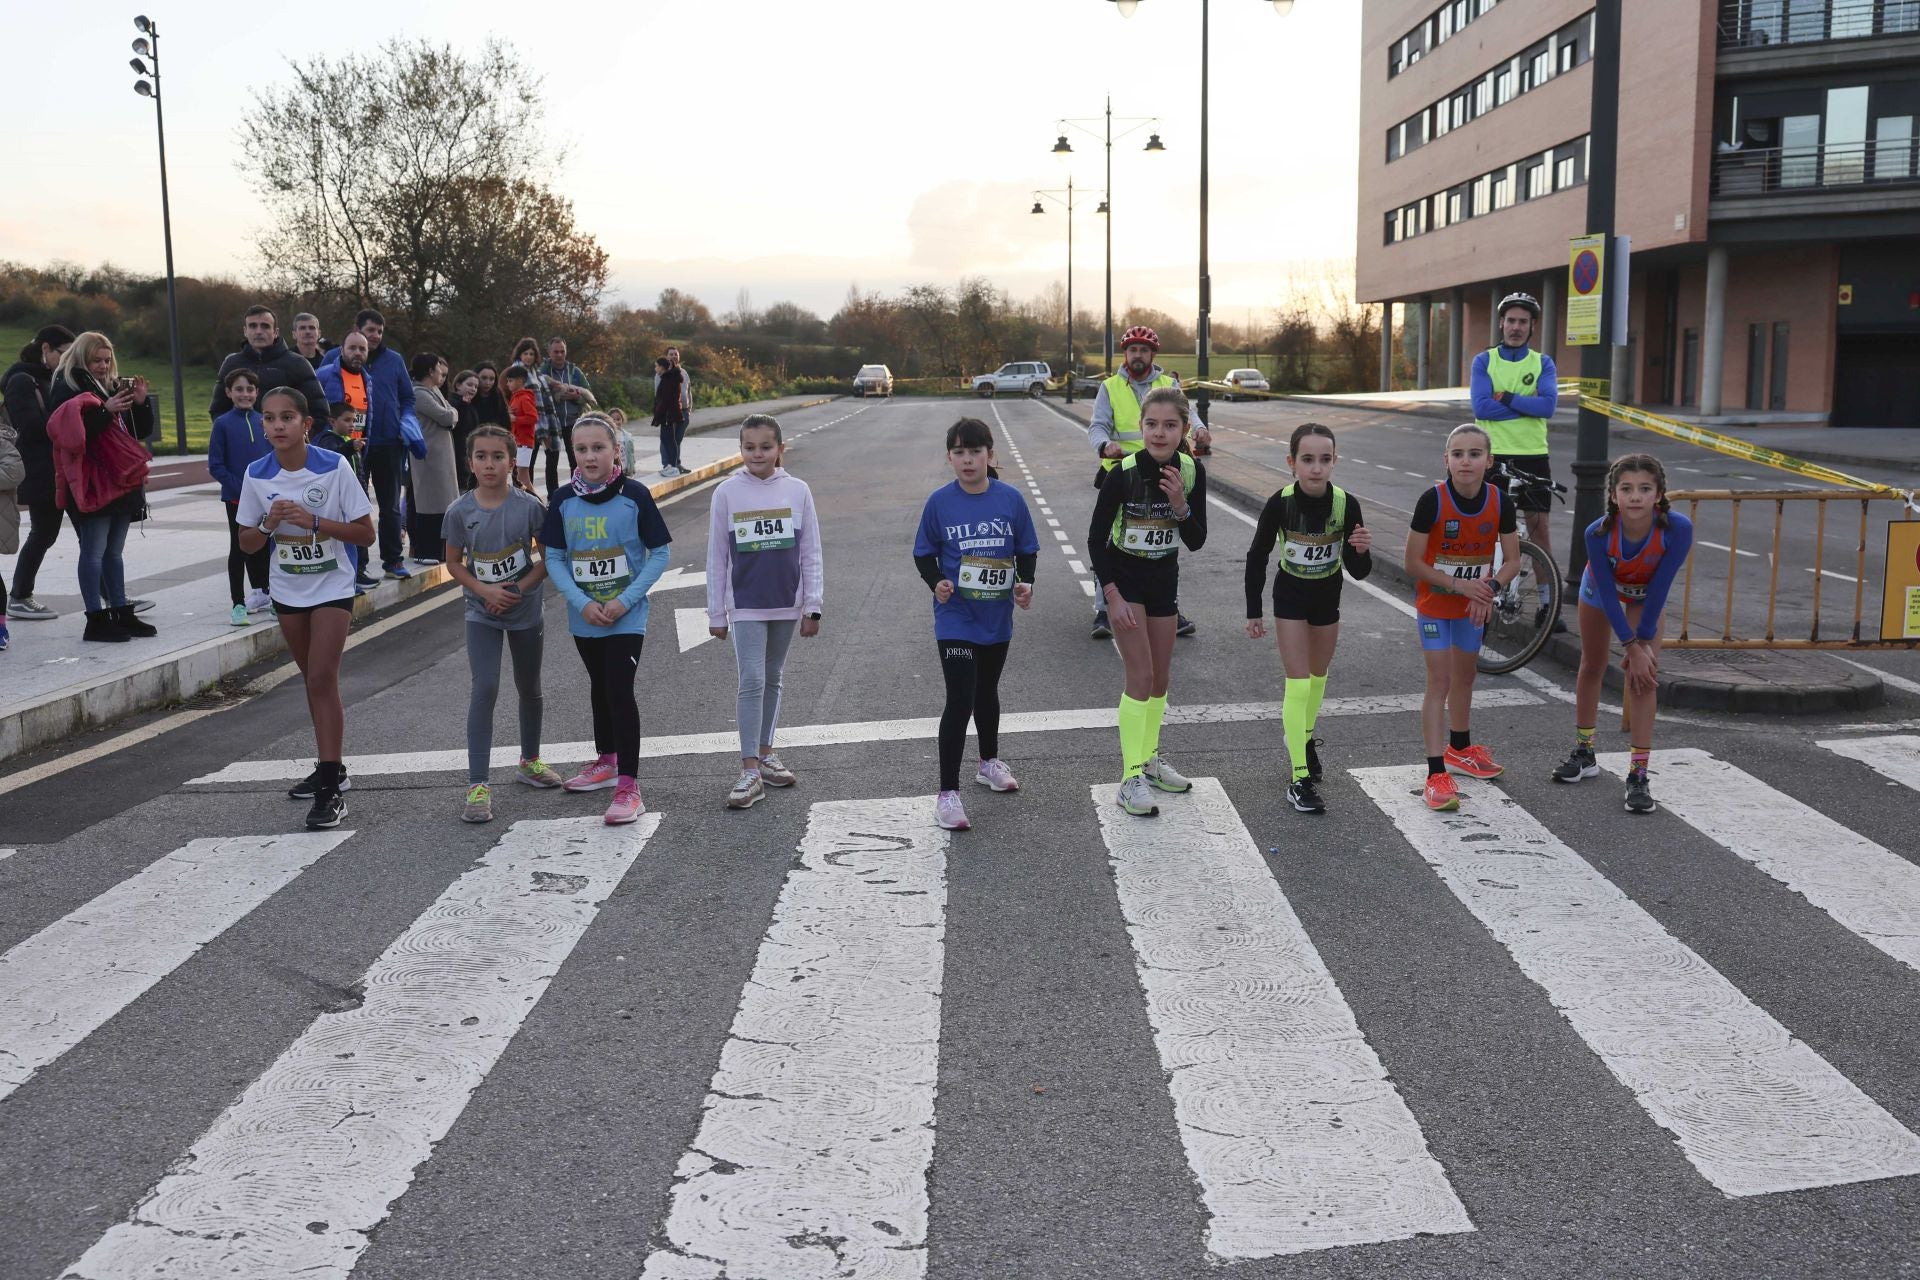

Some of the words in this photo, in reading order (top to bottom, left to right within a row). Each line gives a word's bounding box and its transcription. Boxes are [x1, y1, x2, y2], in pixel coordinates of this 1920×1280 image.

[584, 516, 608, 540] 5K
[754, 519, 784, 535] 454
[962, 538, 1004, 548] DEPORTE
[1144, 529, 1174, 546] 436
[292, 544, 324, 561] 509
[1303, 544, 1333, 561] 424
[491, 556, 518, 577] 412
[589, 558, 616, 577] 427
[1453, 566, 1482, 581] 444
[977, 568, 1007, 586] 459
[945, 647, 974, 660] JORDAN
